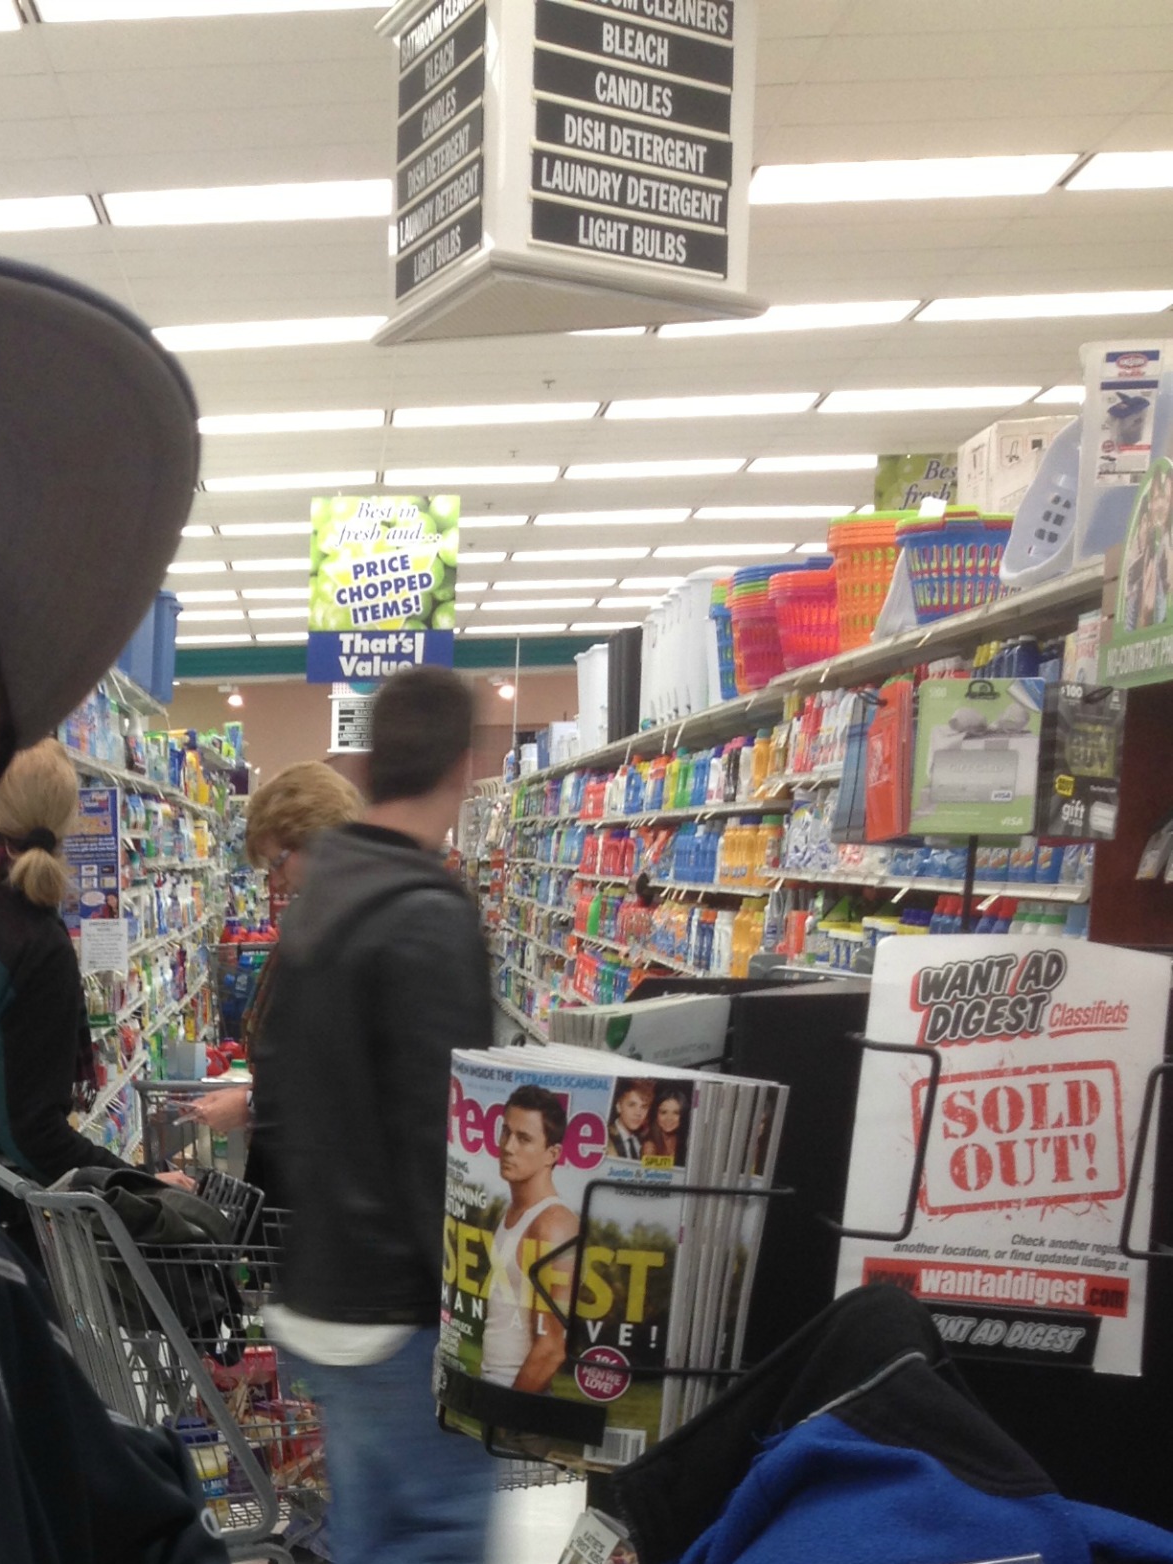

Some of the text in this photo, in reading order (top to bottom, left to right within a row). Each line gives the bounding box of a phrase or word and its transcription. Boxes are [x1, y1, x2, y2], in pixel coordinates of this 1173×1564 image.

[643, 0, 729, 35] CLEANERS
[425, 38, 455, 90] BLEACH
[602, 22, 669, 67] BLEACH
[422, 87, 456, 140] CANDLES
[595, 71, 673, 117] CANDLES
[407, 123, 470, 199] DISH DETERGENT
[564, 114, 707, 173] DISH DETERGENT
[400, 163, 479, 248] LAUNDRY DETERGENT
[541, 157, 723, 223] LAUNDRY DETERGENT
[413, 225, 462, 284] LIGHT BULBS
[578, 215, 687, 264] LIGHT BULBS
[337, 523, 382, 546] fresh
[357, 502, 419, 520] Best in
[336, 572, 433, 606] CHOPPED
[352, 554, 410, 580] PRICE
[352, 594, 421, 625] ITEMS!
[1061, 800, 1085, 822] gift
[919, 949, 1067, 1006] WANT AD
[924, 992, 1130, 1044] DIGEST Classifieds
[497, 1069, 513, 1082] THE
[514, 1069, 563, 1088] PETRAEUS
[563, 1075, 609, 1091] SCANDAL
[942, 1080, 1101, 1140] SOLD
[949, 1132, 1099, 1192] OUT!
[893, 1241, 937, 1256] another
[995, 1249, 1007, 1261] or
[1010, 1249, 1032, 1262] find
[1035, 1252, 1078, 1267] updated
[1081, 1256, 1116, 1272] listings
[1011, 1233, 1046, 1248] Check
[1050, 1238, 1090, 1252] another
[443, 1223, 665, 1324] SEXIEST
[931, 1313, 1085, 1352] ANT AD DIGEST
